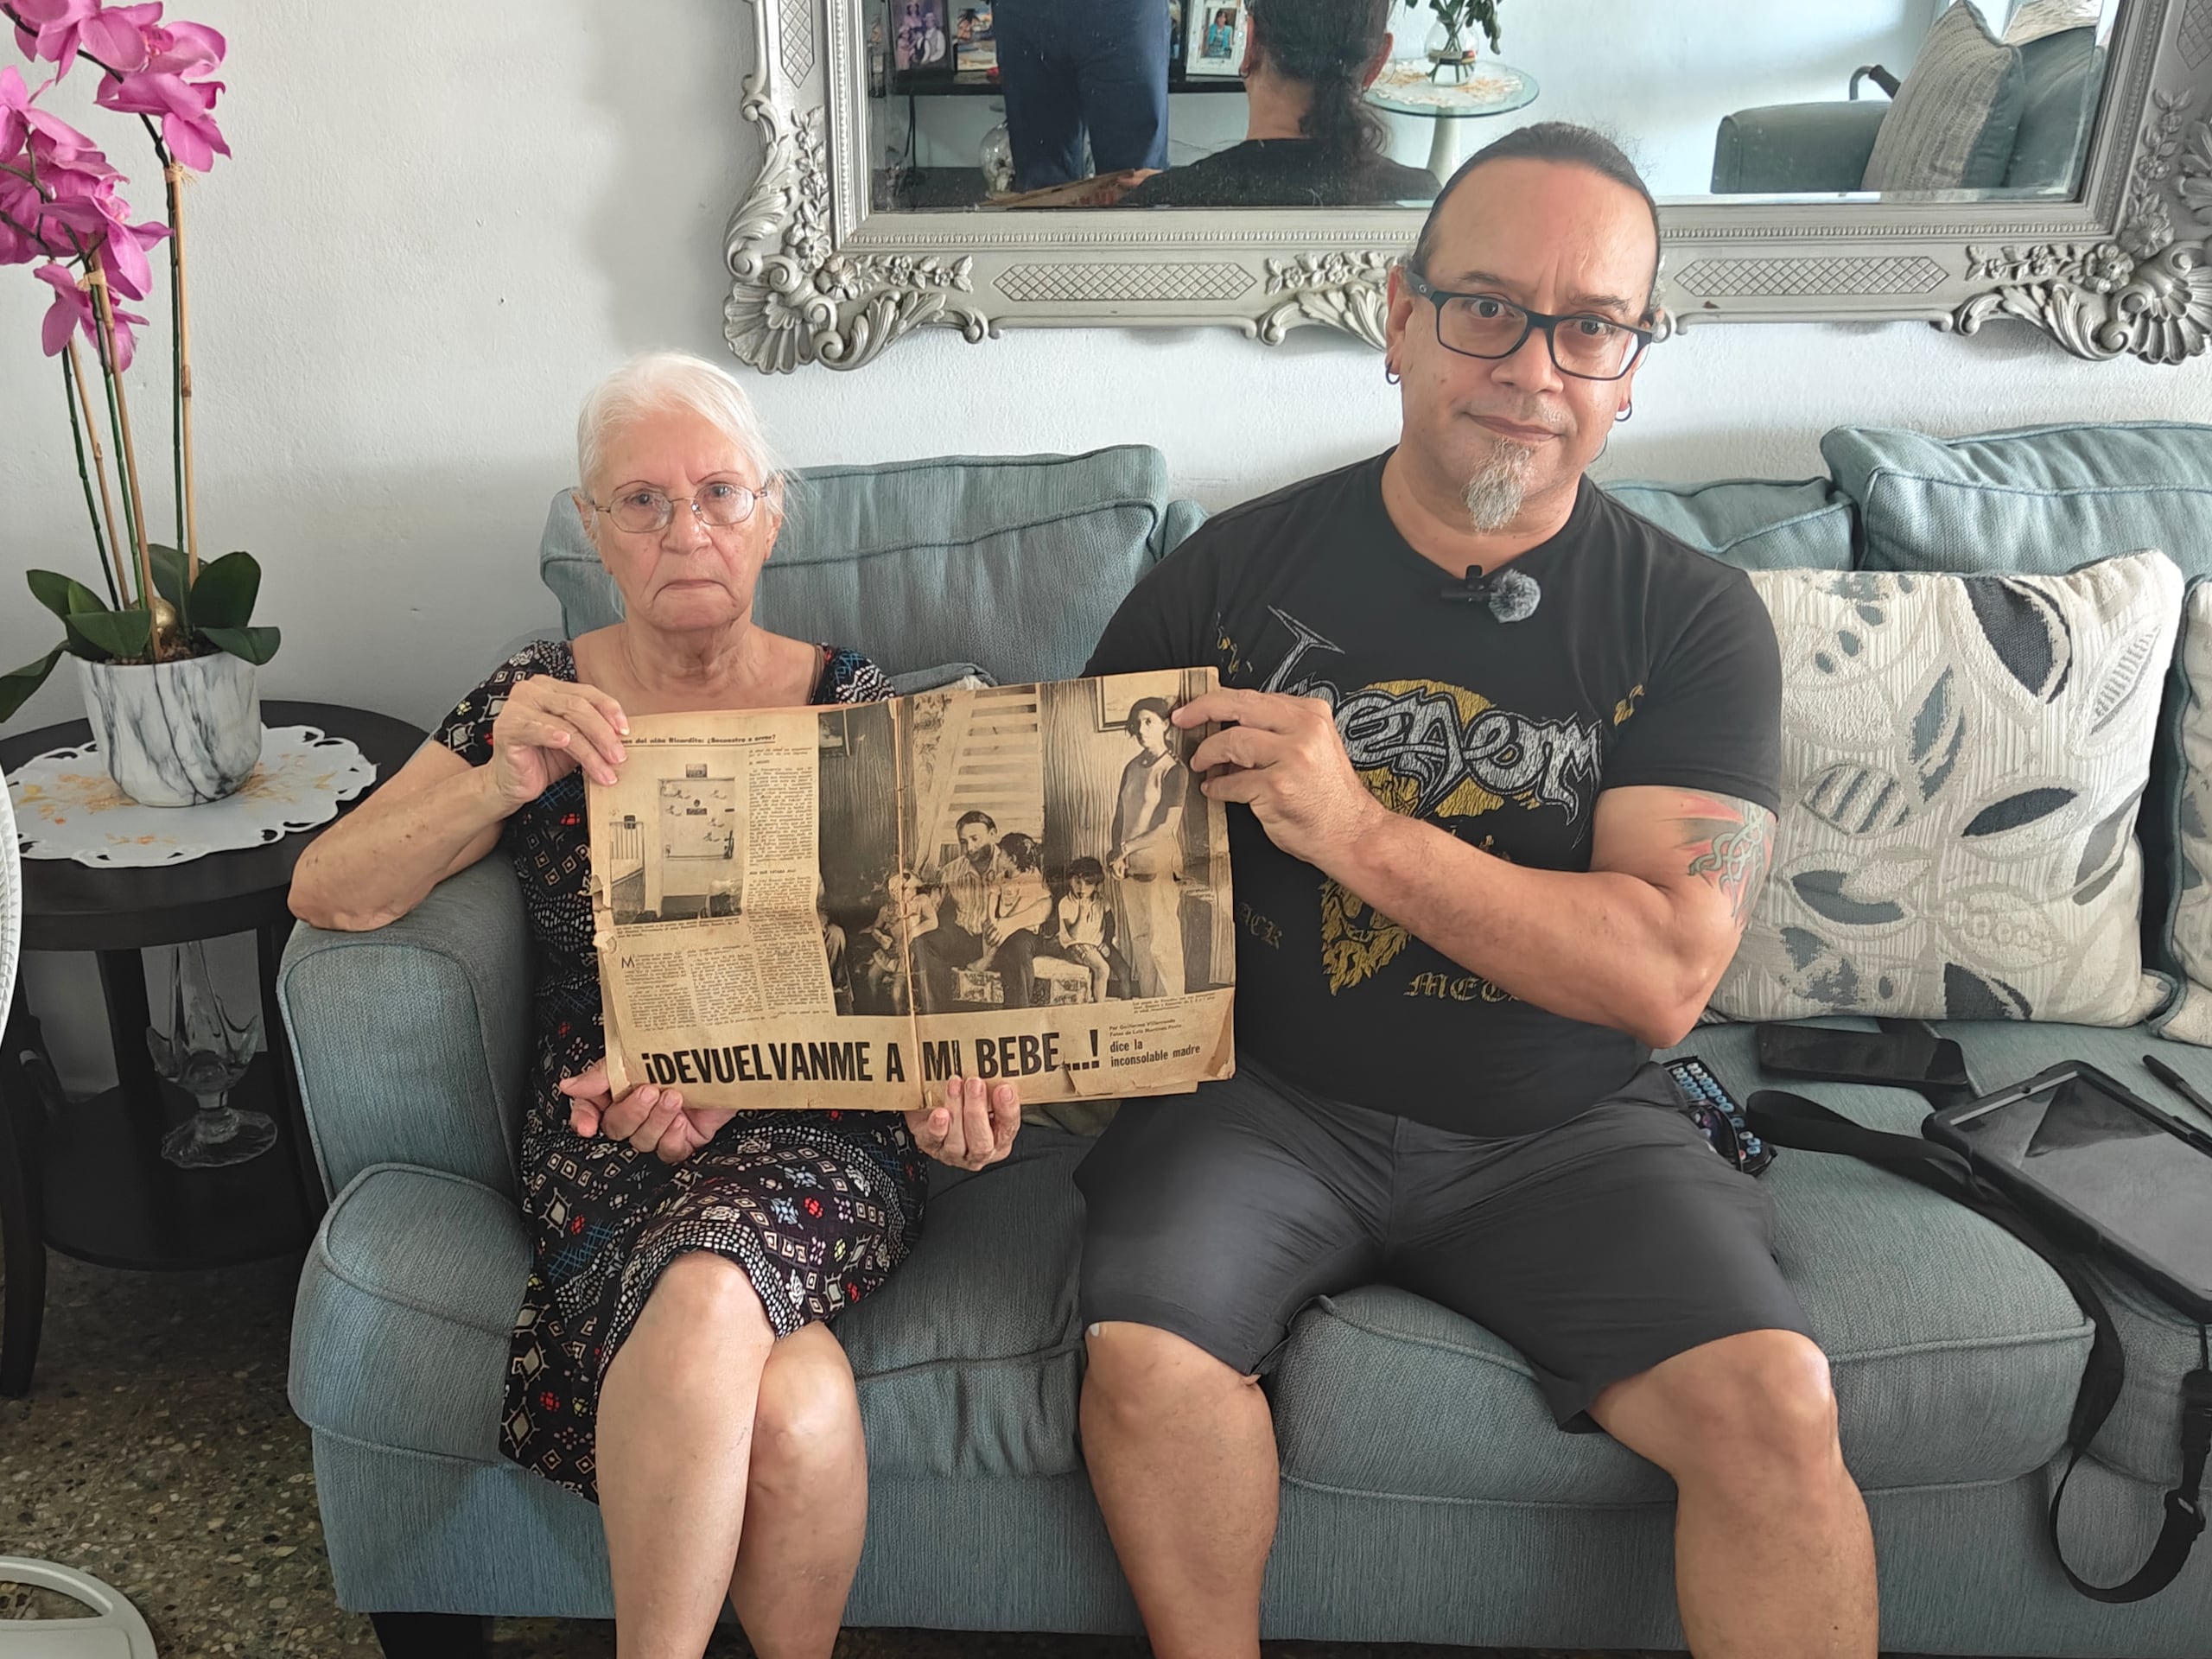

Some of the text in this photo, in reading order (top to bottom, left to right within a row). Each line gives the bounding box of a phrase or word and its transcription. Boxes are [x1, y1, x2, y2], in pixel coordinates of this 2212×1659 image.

[1237, 902, 1283, 950] ACK
[1402, 971, 1521, 1003] MET
[1109, 1038, 1143, 1053] dice la
[1110, 1044, 1201, 1068] inconsolable madre
[641, 1040, 874, 1085] ¡DEVUELVANME
[886, 1042, 906, 1083] A
[922, 1039, 971, 1081] MI
